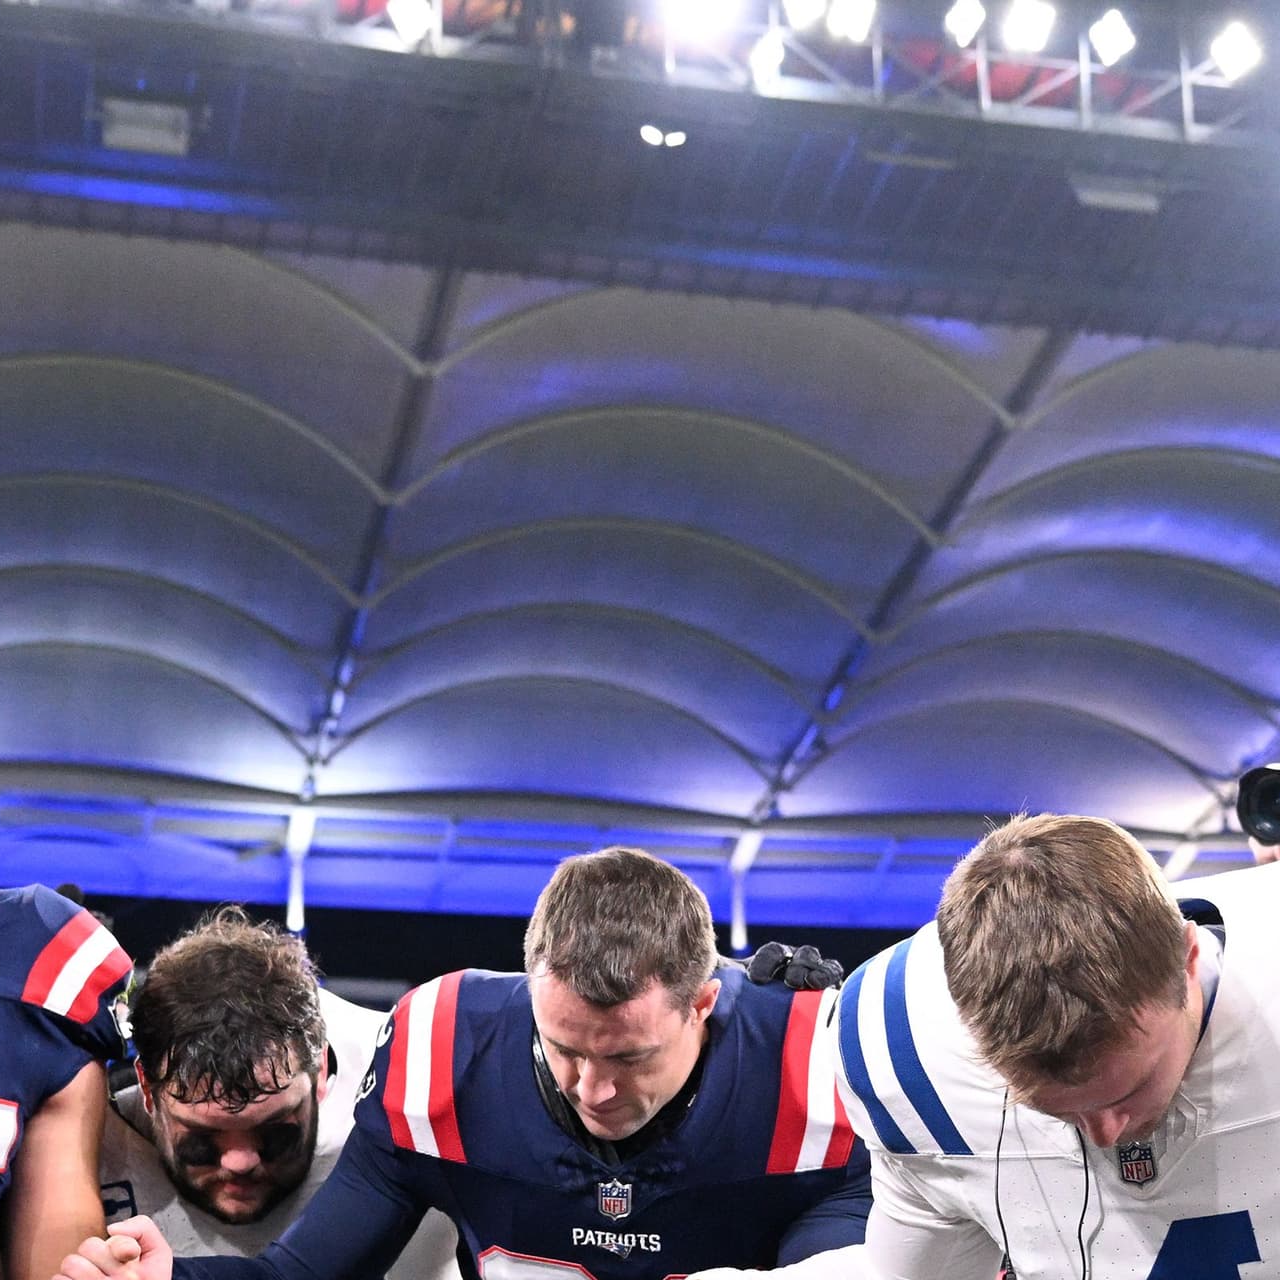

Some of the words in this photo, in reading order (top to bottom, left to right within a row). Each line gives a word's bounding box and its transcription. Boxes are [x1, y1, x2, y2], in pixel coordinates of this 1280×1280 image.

[1123, 1160, 1153, 1180] NFL
[603, 1199, 627, 1213] NFL
[572, 1227, 662, 1253] PATRIOTS
